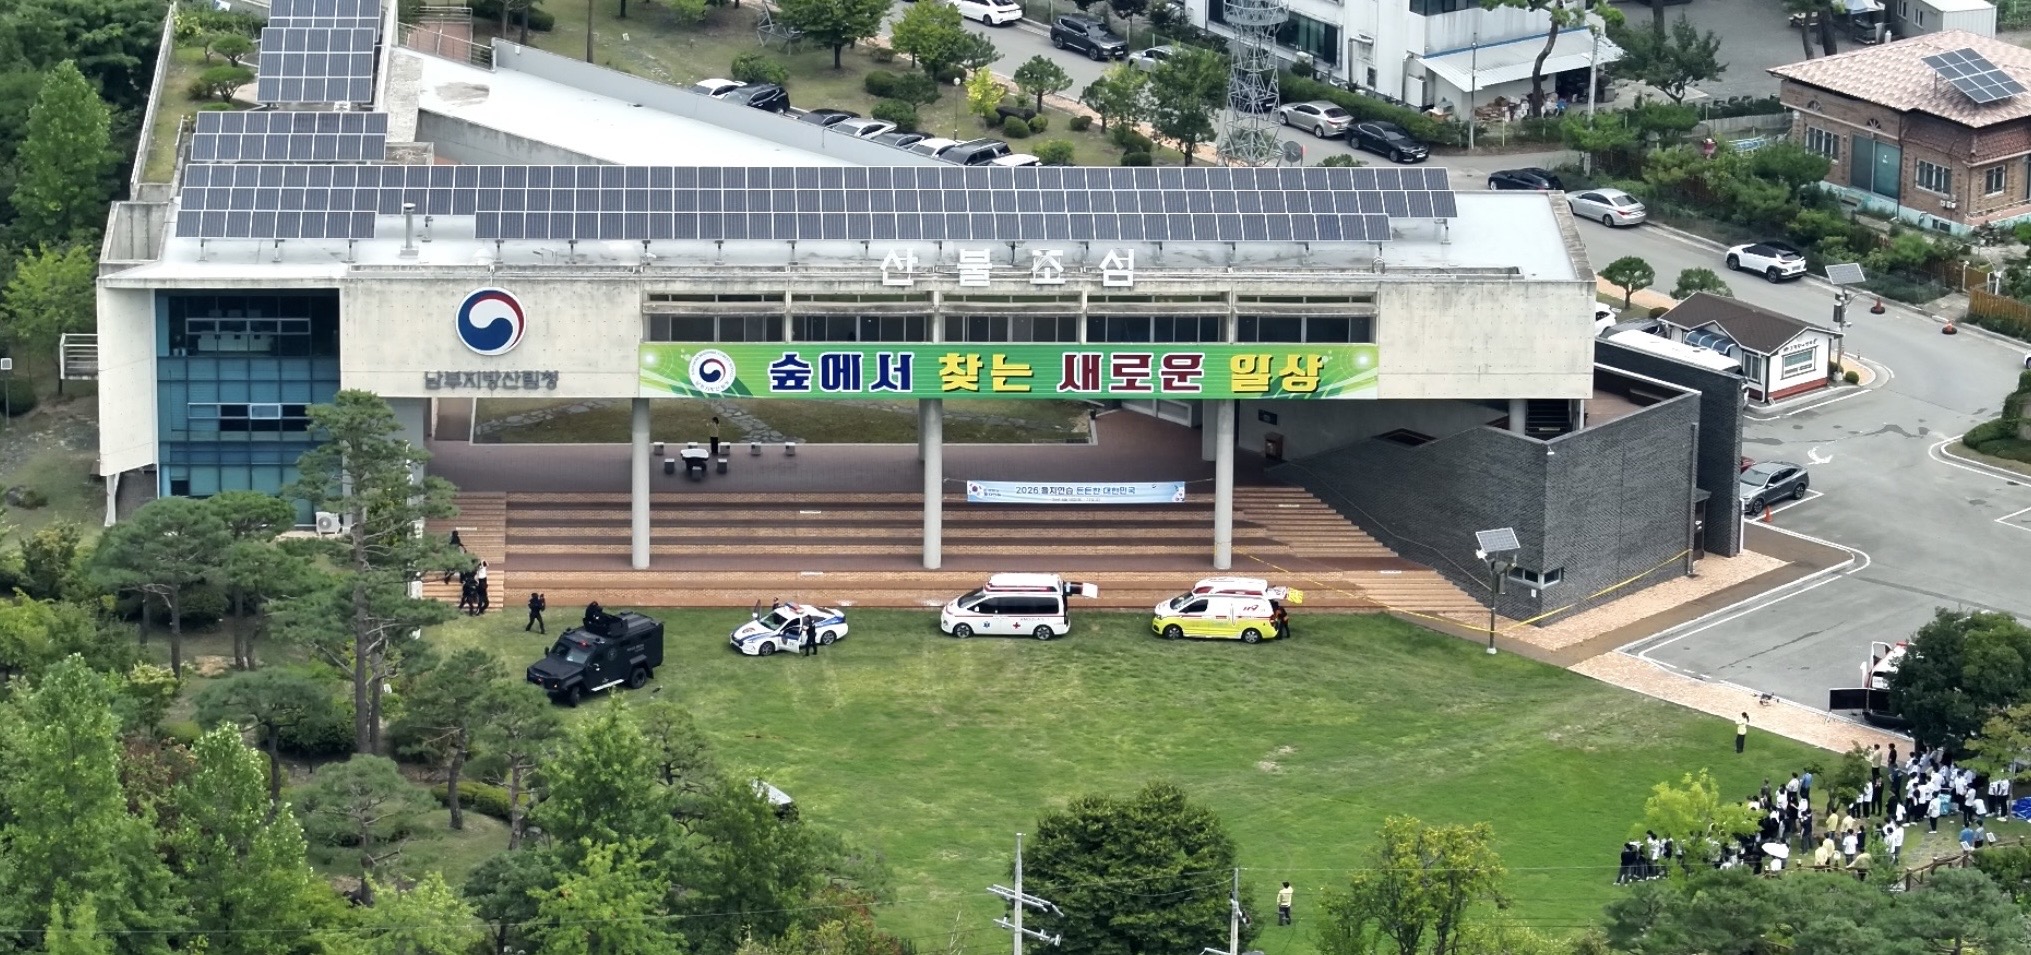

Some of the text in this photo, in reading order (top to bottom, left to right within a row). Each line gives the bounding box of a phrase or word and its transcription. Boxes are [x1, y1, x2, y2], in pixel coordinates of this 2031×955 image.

[425, 370, 559, 391] 남부지방산림청
[769, 352, 914, 392] 숲에서
[938, 353, 1033, 392] 찾는
[1057, 352, 1205, 393] 새로운
[1230, 354, 1323, 393] 일상
[1016, 486, 1039, 495] 2026
[1102, 486, 1136, 496] 대한민국
